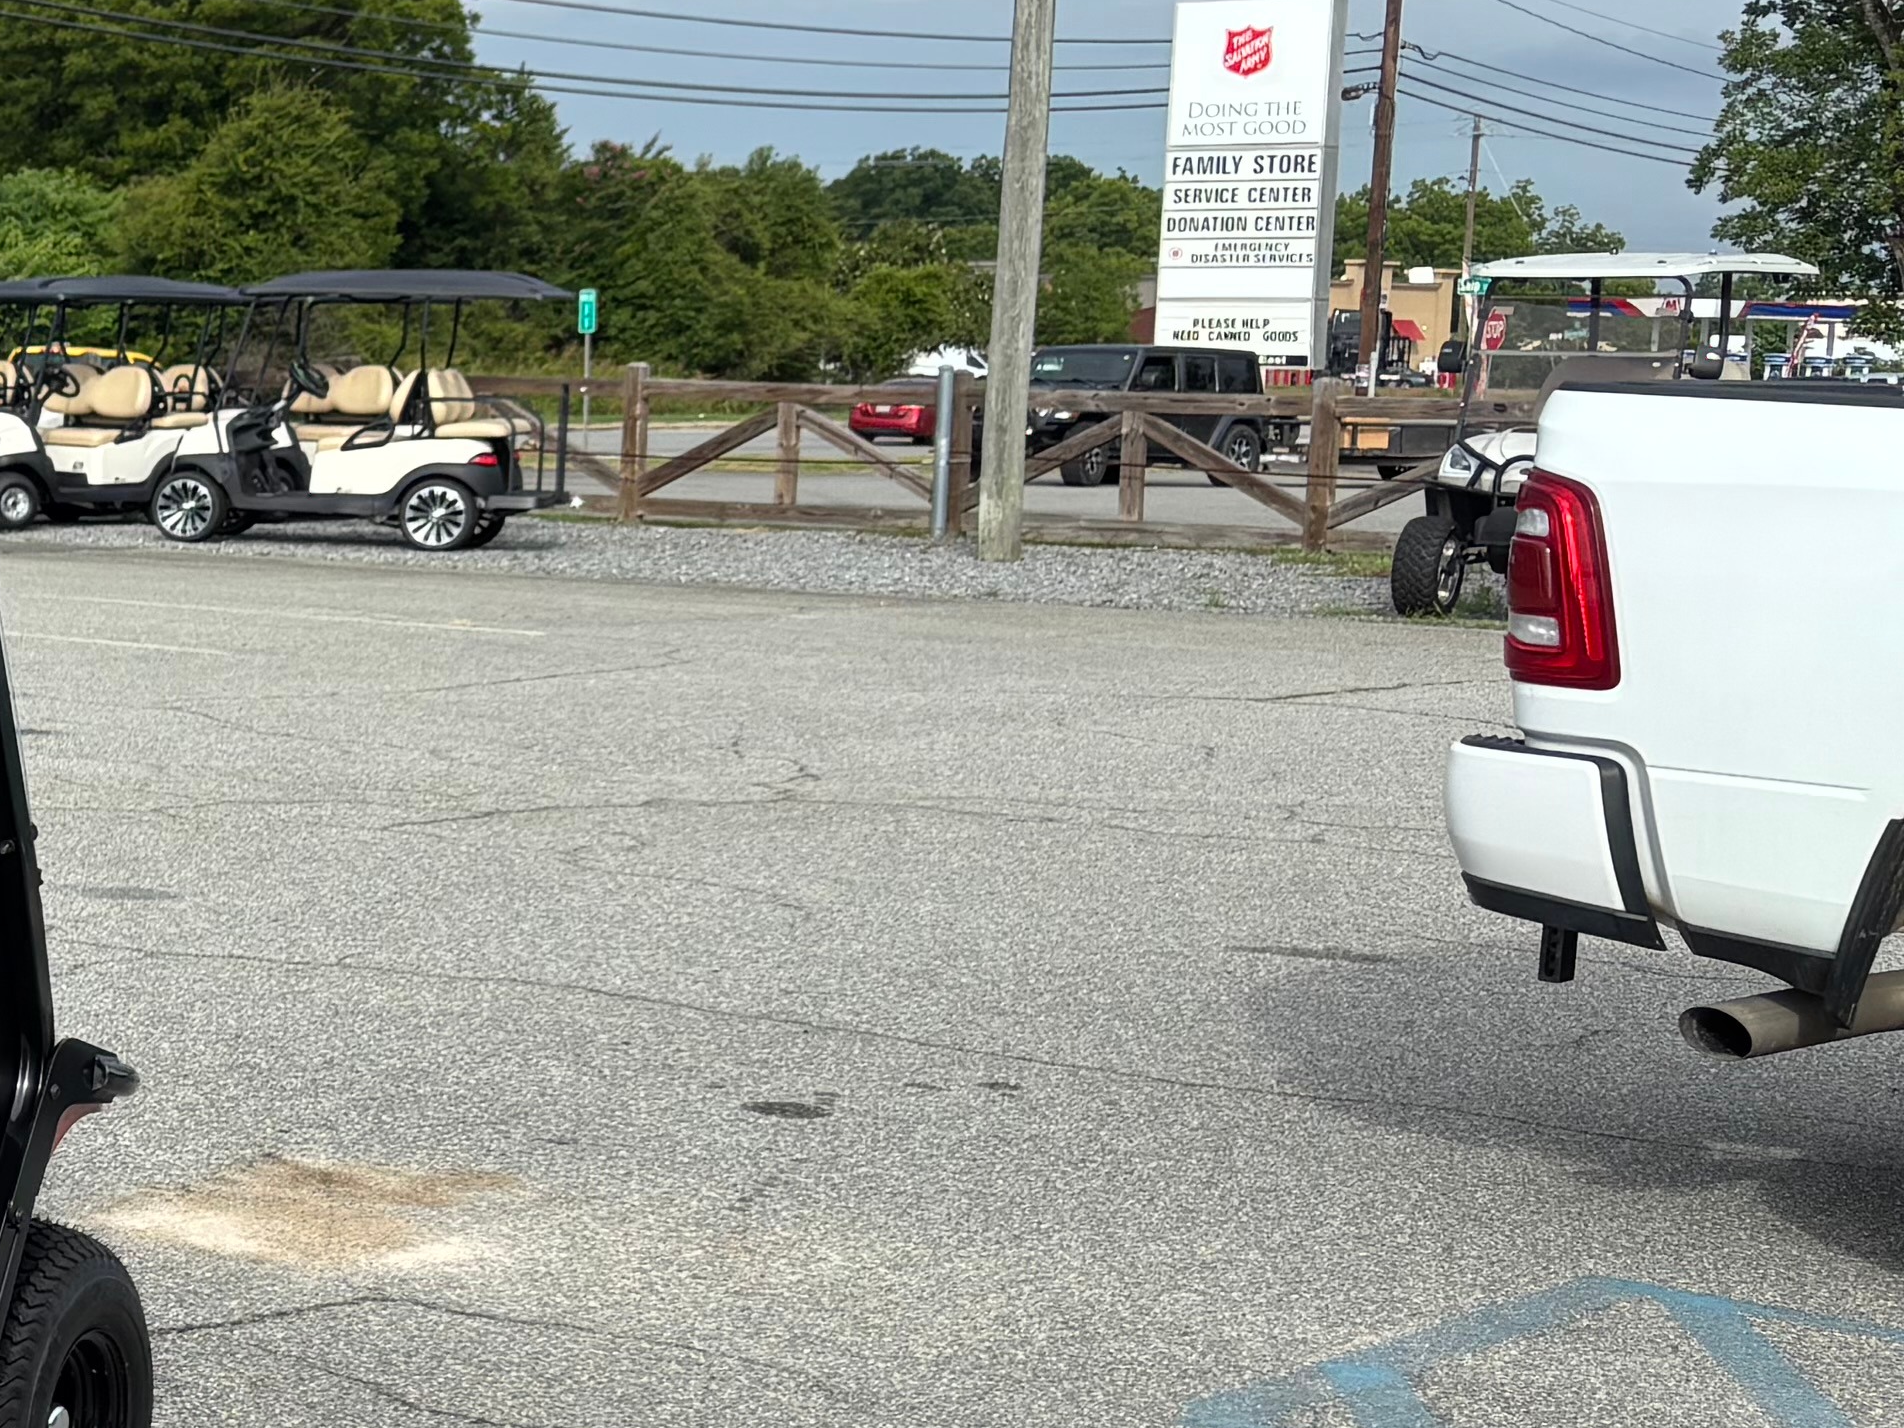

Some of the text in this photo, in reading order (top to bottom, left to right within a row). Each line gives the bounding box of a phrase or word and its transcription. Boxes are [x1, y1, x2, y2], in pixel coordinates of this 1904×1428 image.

[1188, 100, 1302, 119] DOING THE
[1182, 119, 1307, 137] MOST GOOD
[1172, 154, 1318, 176] FAMILY STORE
[1173, 187, 1312, 204] SERVICE CENTER
[1166, 215, 1316, 233] DONATION CENTER
[1193, 318, 1237, 329] PLEASE
[1486, 321, 1504, 339] STOP
[1262, 331, 1299, 342] GOODS
